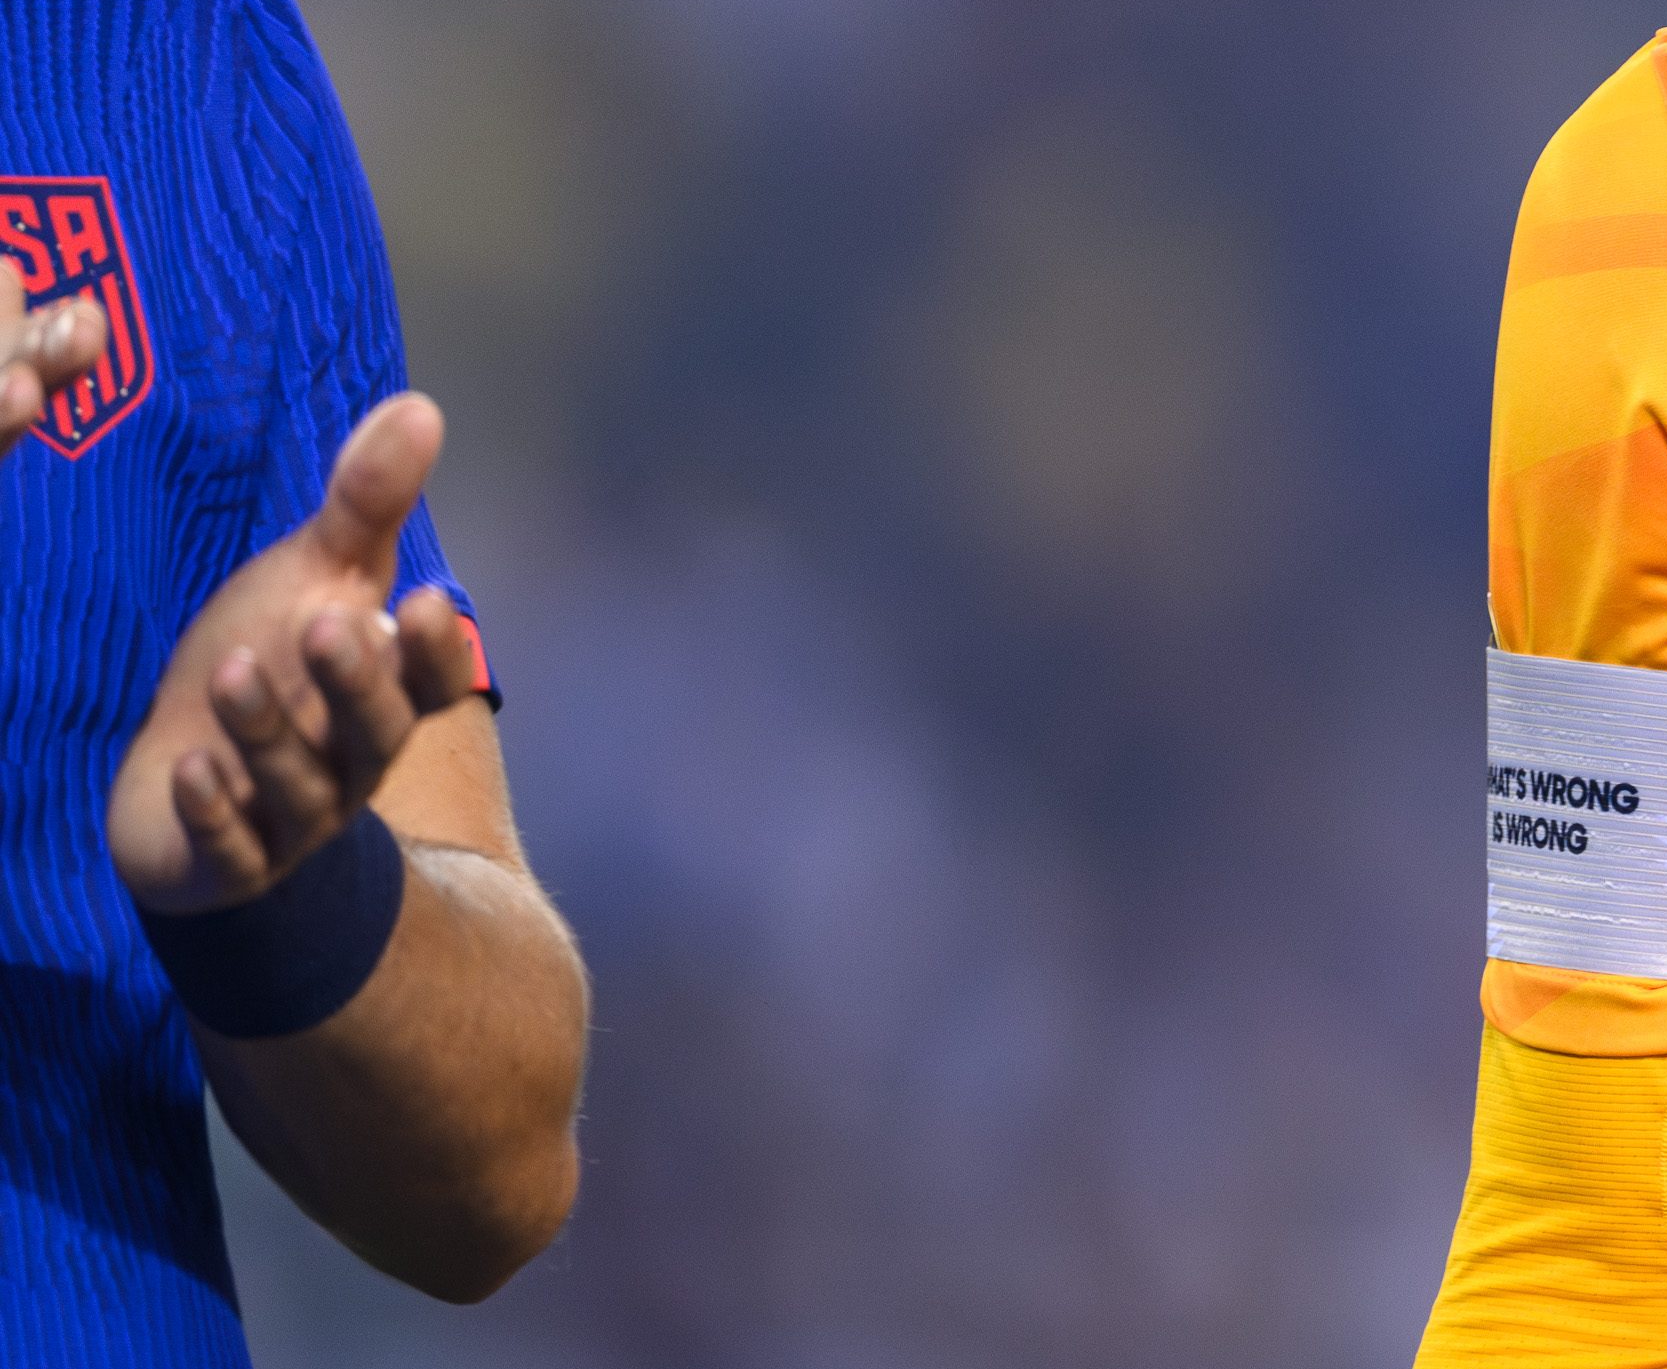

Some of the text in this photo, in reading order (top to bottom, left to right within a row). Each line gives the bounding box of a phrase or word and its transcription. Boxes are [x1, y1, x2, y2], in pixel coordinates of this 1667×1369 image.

[0, 195, 108, 294] SA
[1488, 765, 1639, 814] HAT'S WRONG
[1493, 810, 1588, 855] IS WRONG
